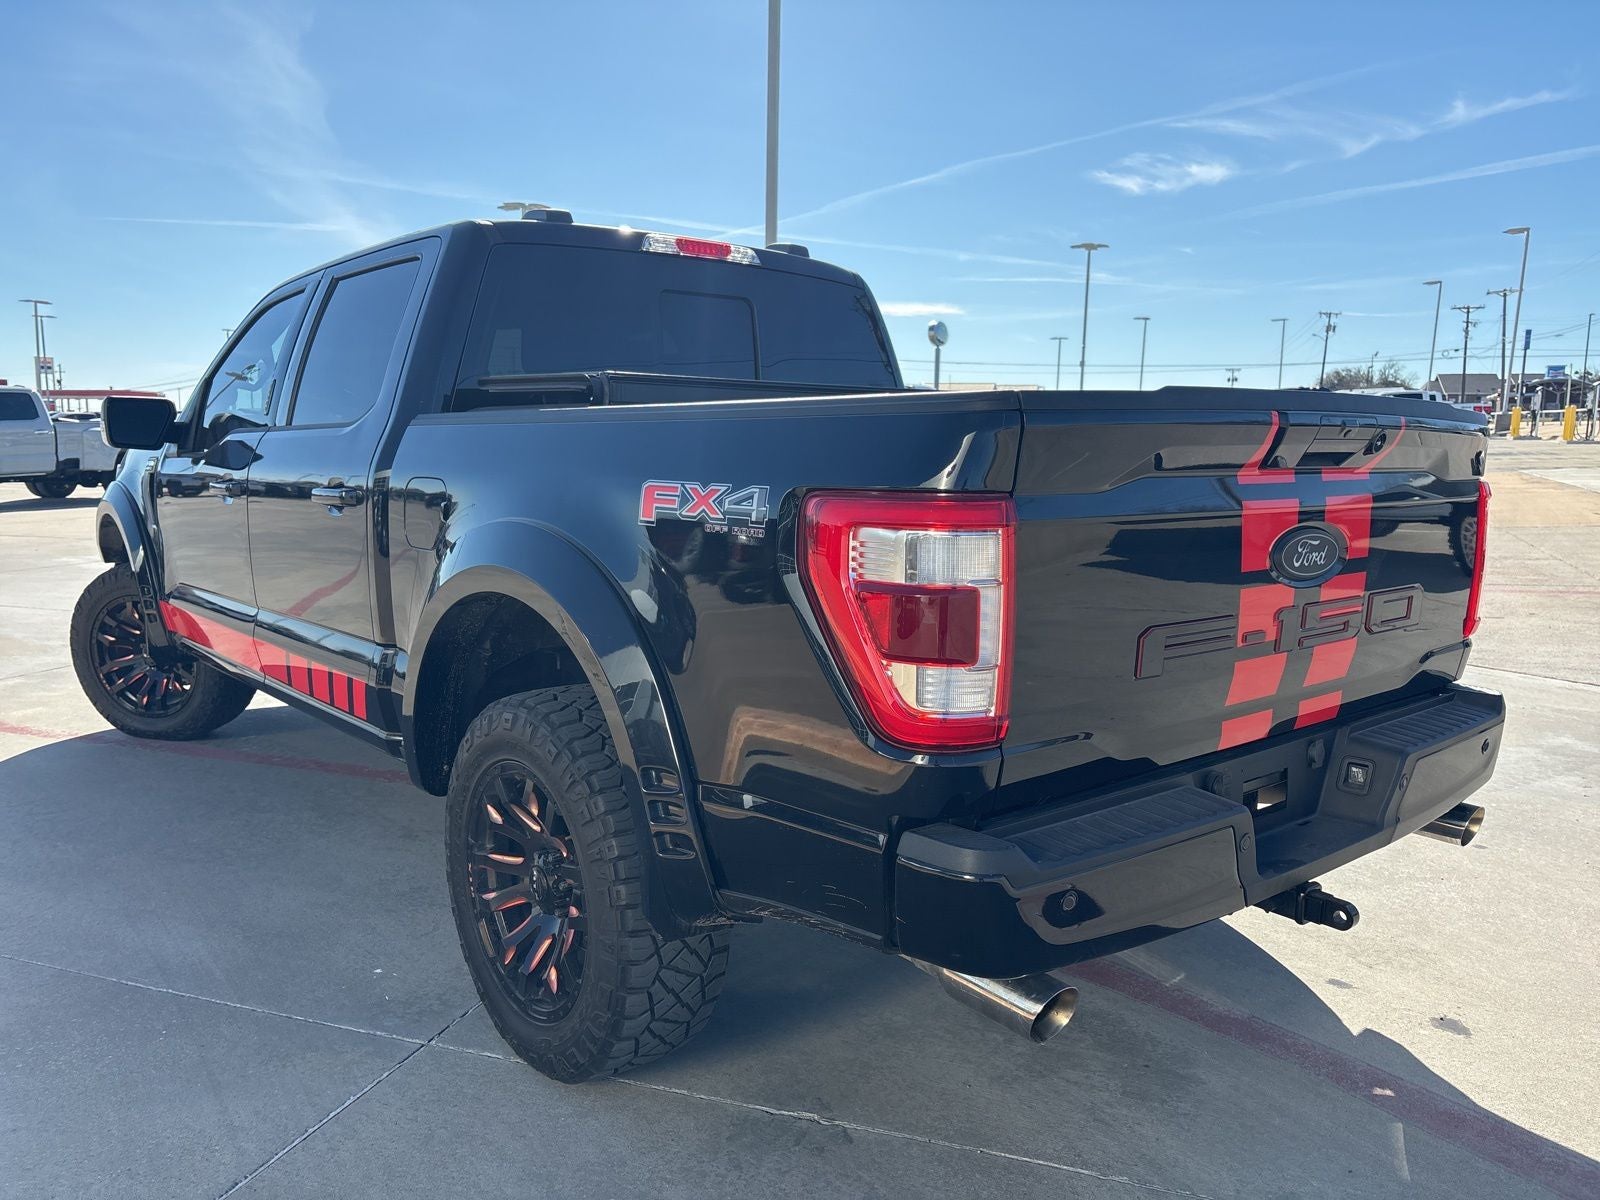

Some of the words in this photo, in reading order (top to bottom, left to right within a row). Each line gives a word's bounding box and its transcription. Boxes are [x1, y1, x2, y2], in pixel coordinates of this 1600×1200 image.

[638, 479, 770, 527] FX4
[704, 523, 729, 533] OFF
[731, 526, 766, 538] ROAD
[1293, 539, 1328, 567] Ford
[1133, 583, 1425, 680] F-150
